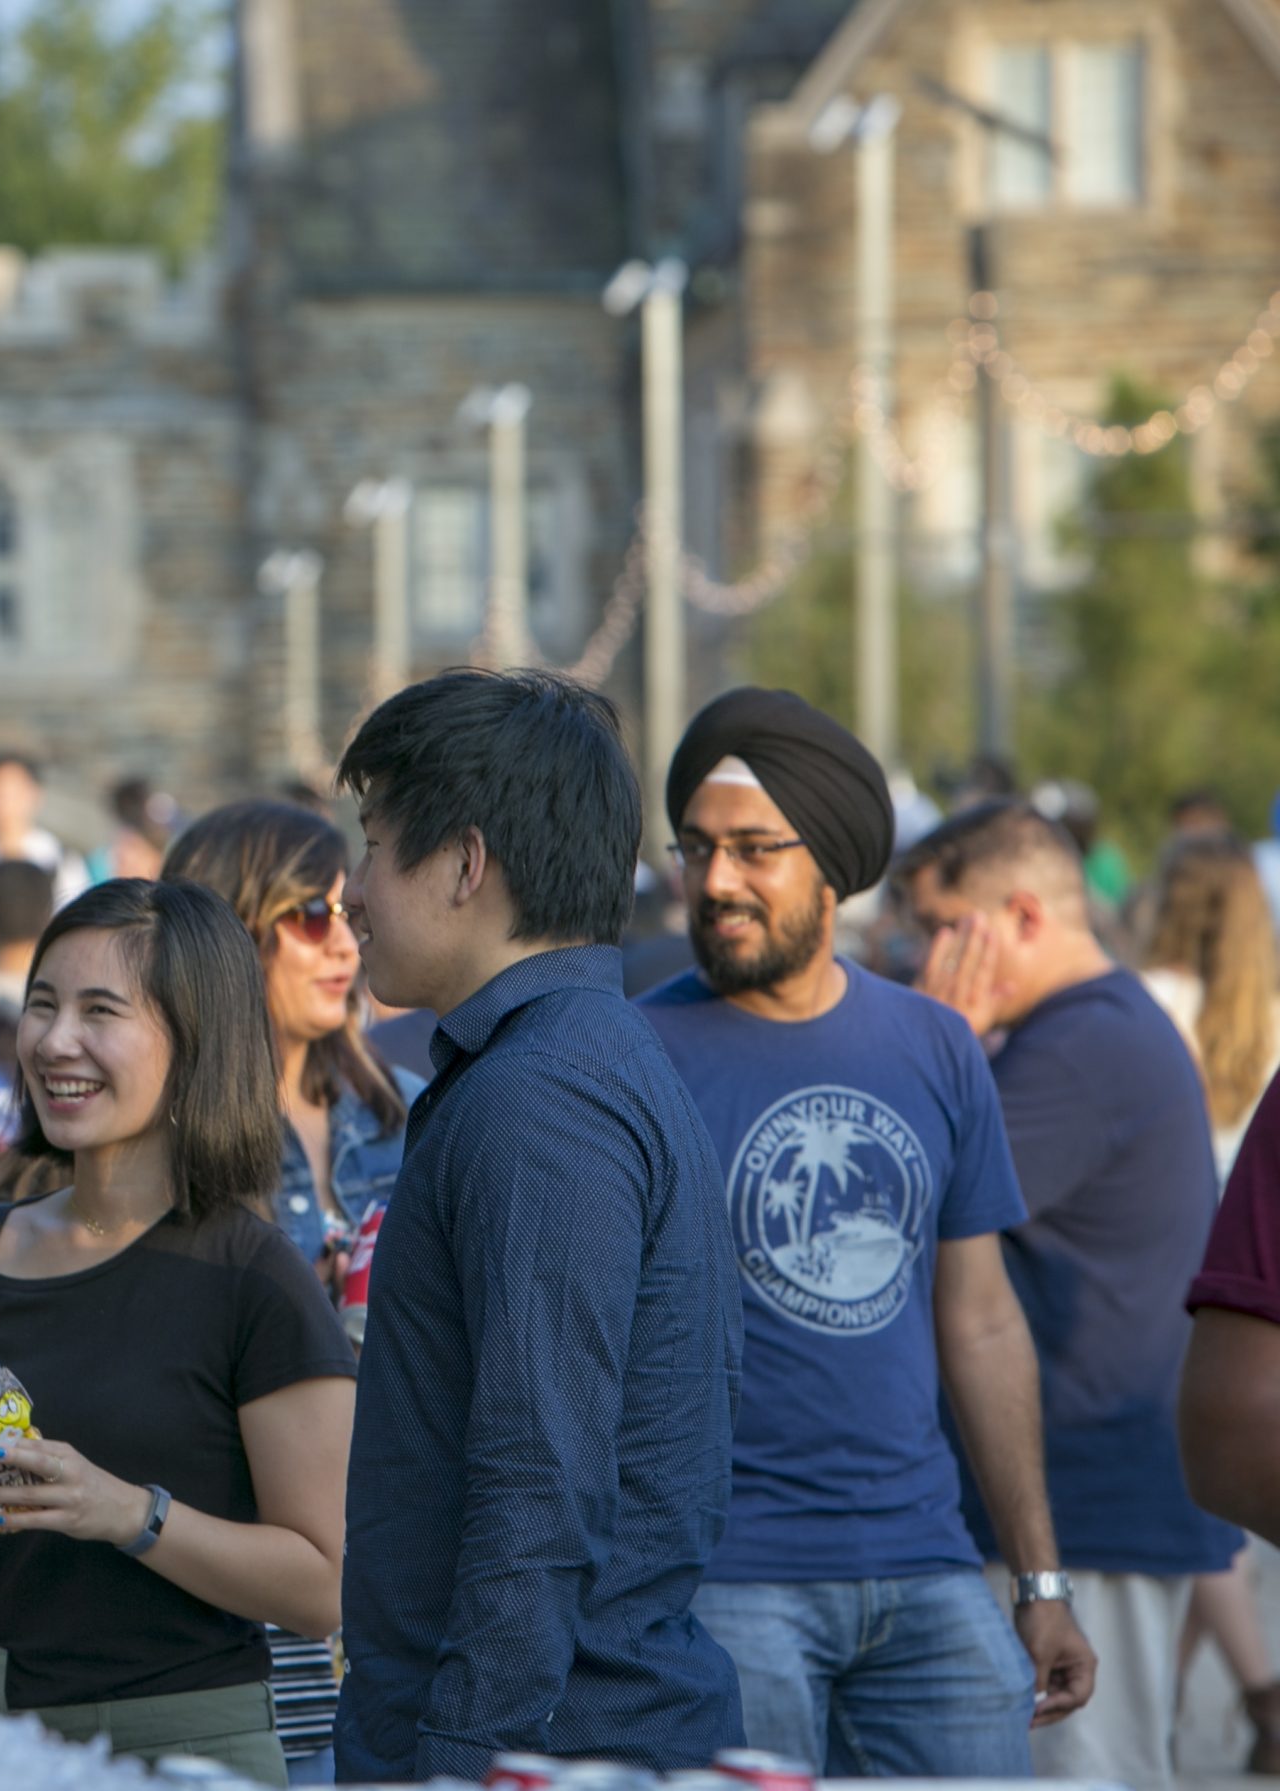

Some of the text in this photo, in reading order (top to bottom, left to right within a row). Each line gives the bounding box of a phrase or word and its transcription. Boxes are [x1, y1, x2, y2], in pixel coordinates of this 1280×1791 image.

[744, 1095, 917, 1172] OWN YOUR WAY
